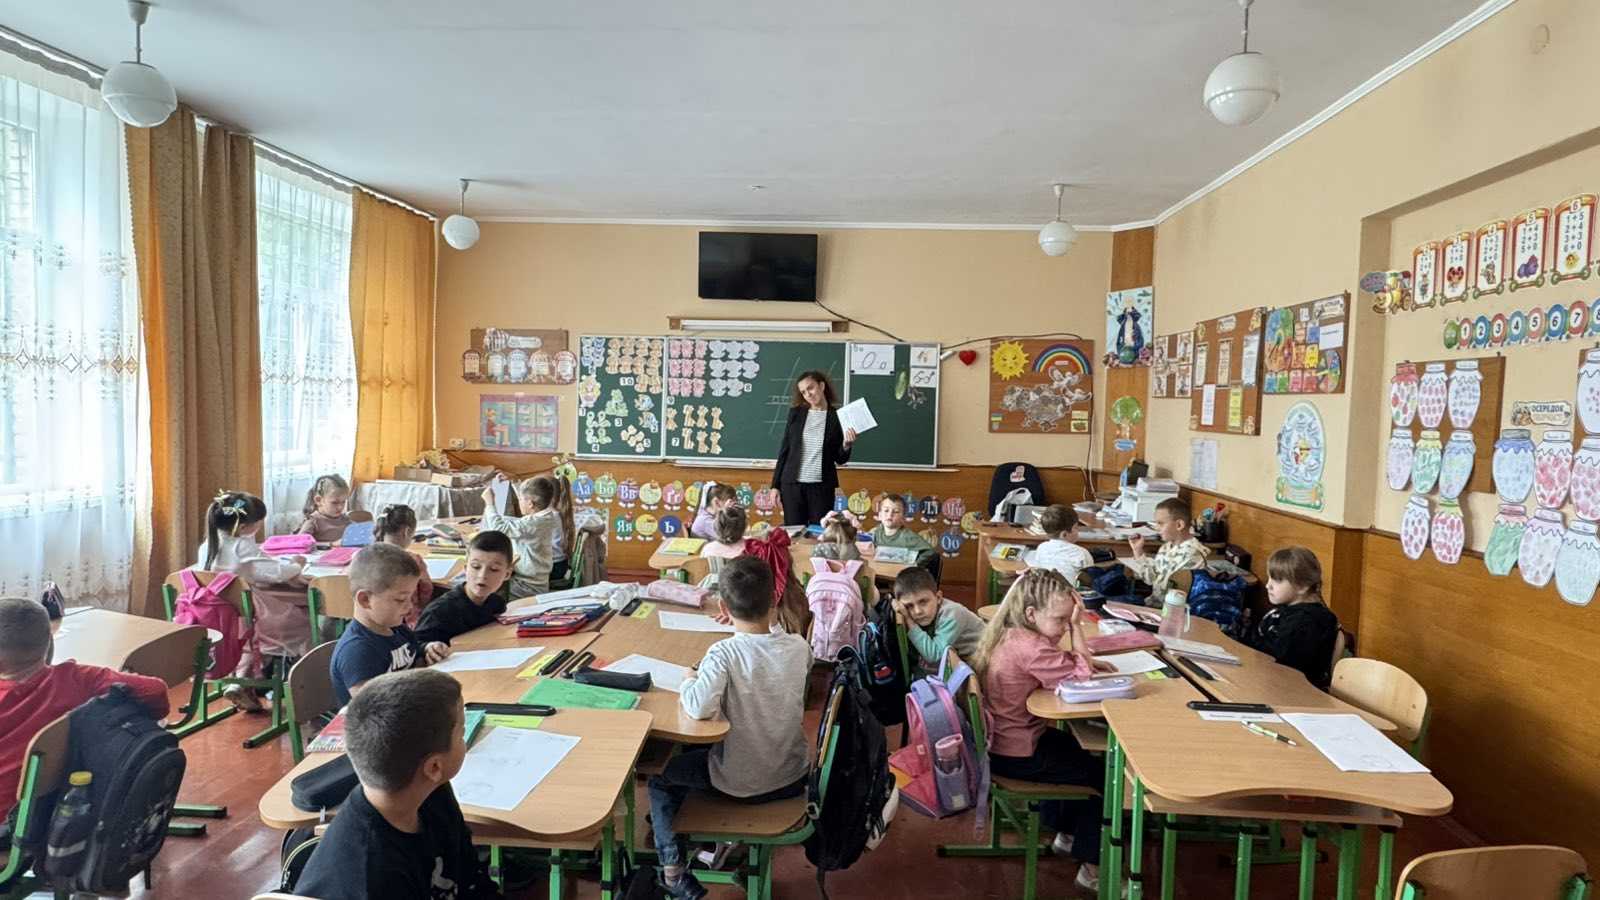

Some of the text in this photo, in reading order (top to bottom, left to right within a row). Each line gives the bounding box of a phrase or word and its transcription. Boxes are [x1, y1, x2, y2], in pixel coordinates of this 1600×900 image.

[1496, 324, 1501, 334] 3
[1513, 320, 1519, 330] 4
[1532, 316, 1538, 327] 5
[1552, 316, 1558, 327] 6
[1574, 313, 1581, 323] 7
[576, 485, 590, 495] Аа
[621, 485, 636, 499] Вв
[617, 520, 633, 533] Яя
[942, 535, 960, 550] Оо
